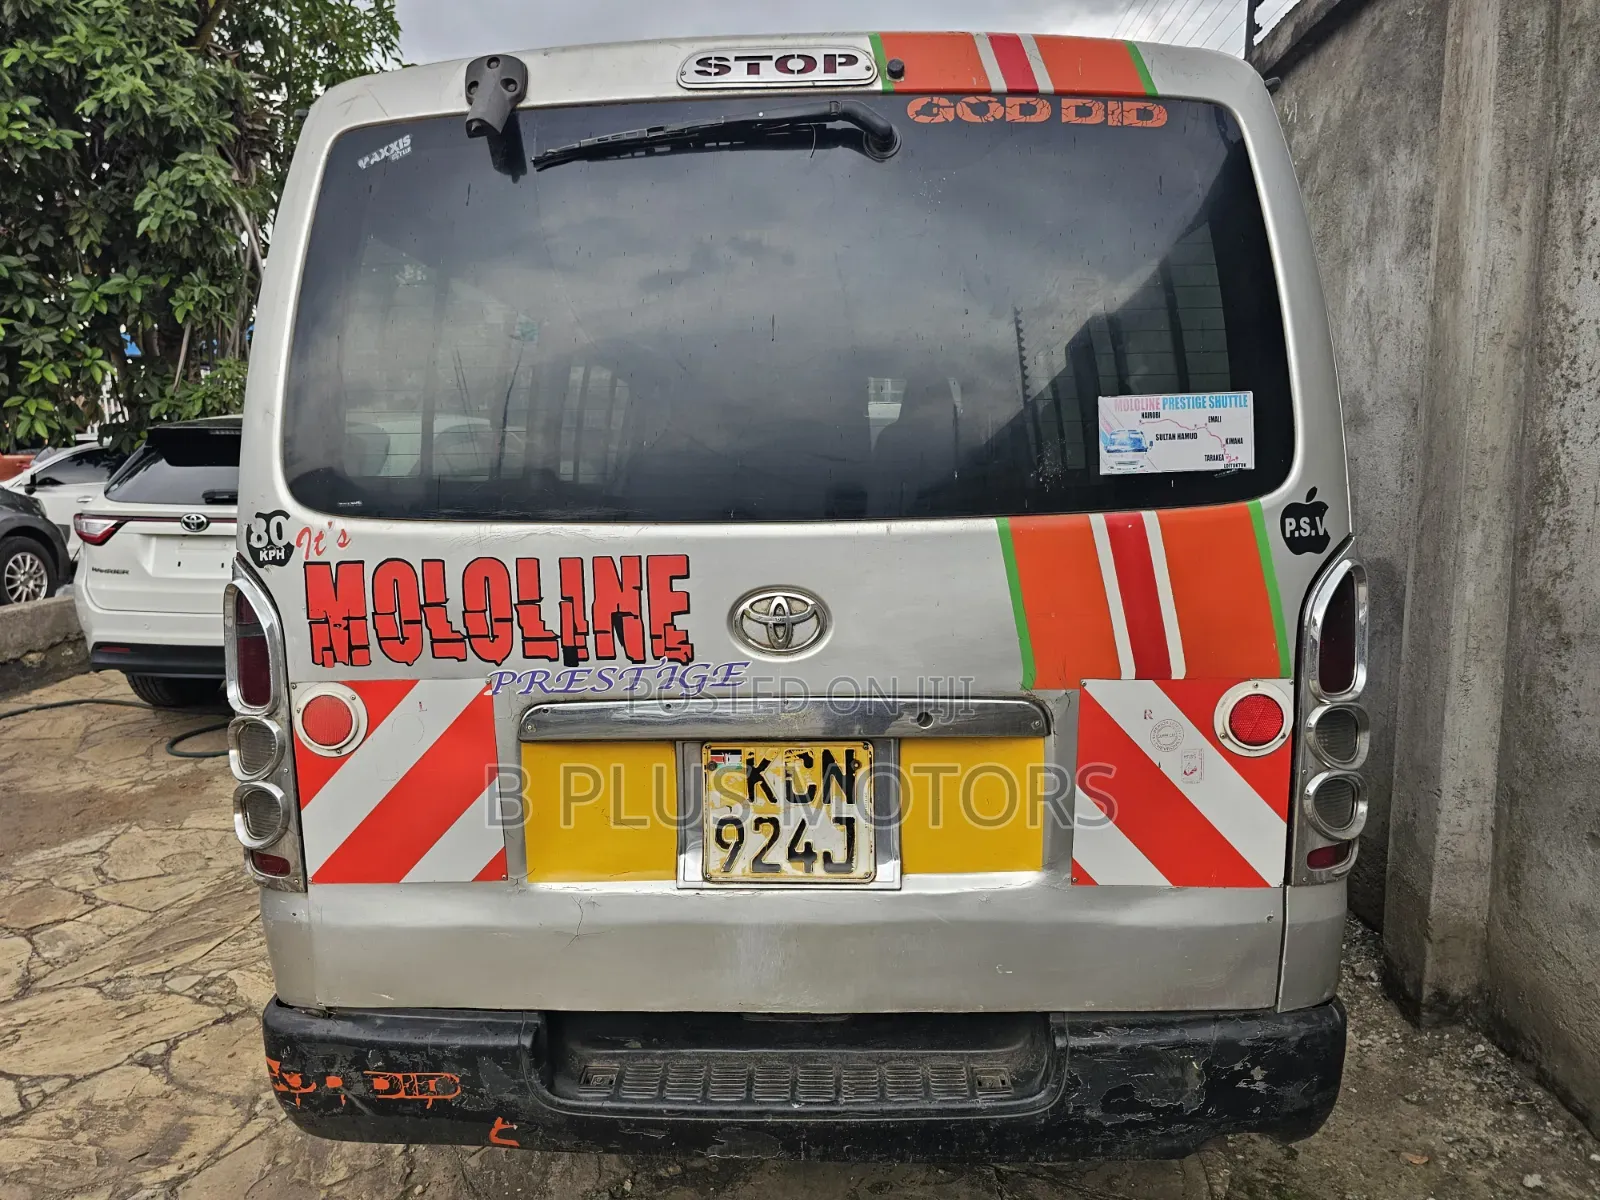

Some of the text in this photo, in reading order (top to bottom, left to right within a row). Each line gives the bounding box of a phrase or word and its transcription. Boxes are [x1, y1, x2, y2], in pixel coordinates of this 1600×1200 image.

[694, 53, 859, 77] STOP
[907, 96, 1168, 128] GOD DID
[1114, 394, 1249, 412] MOLOLINE PRESTIGE SHUTTLE
[1141, 411, 1161, 419] NAIROBI
[1208, 415, 1222, 423] EMALI
[1155, 431, 1198, 441] SULTAN HAMUD
[250, 515, 290, 549] 80
[296, 521, 352, 561] It's
[259, 549, 286, 562] KPH
[303, 554, 695, 667] MOLOLINE
[487, 656, 752, 698] PRESTIGE
[745, 748, 857, 805] KCN
[714, 815, 857, 875] 924J
